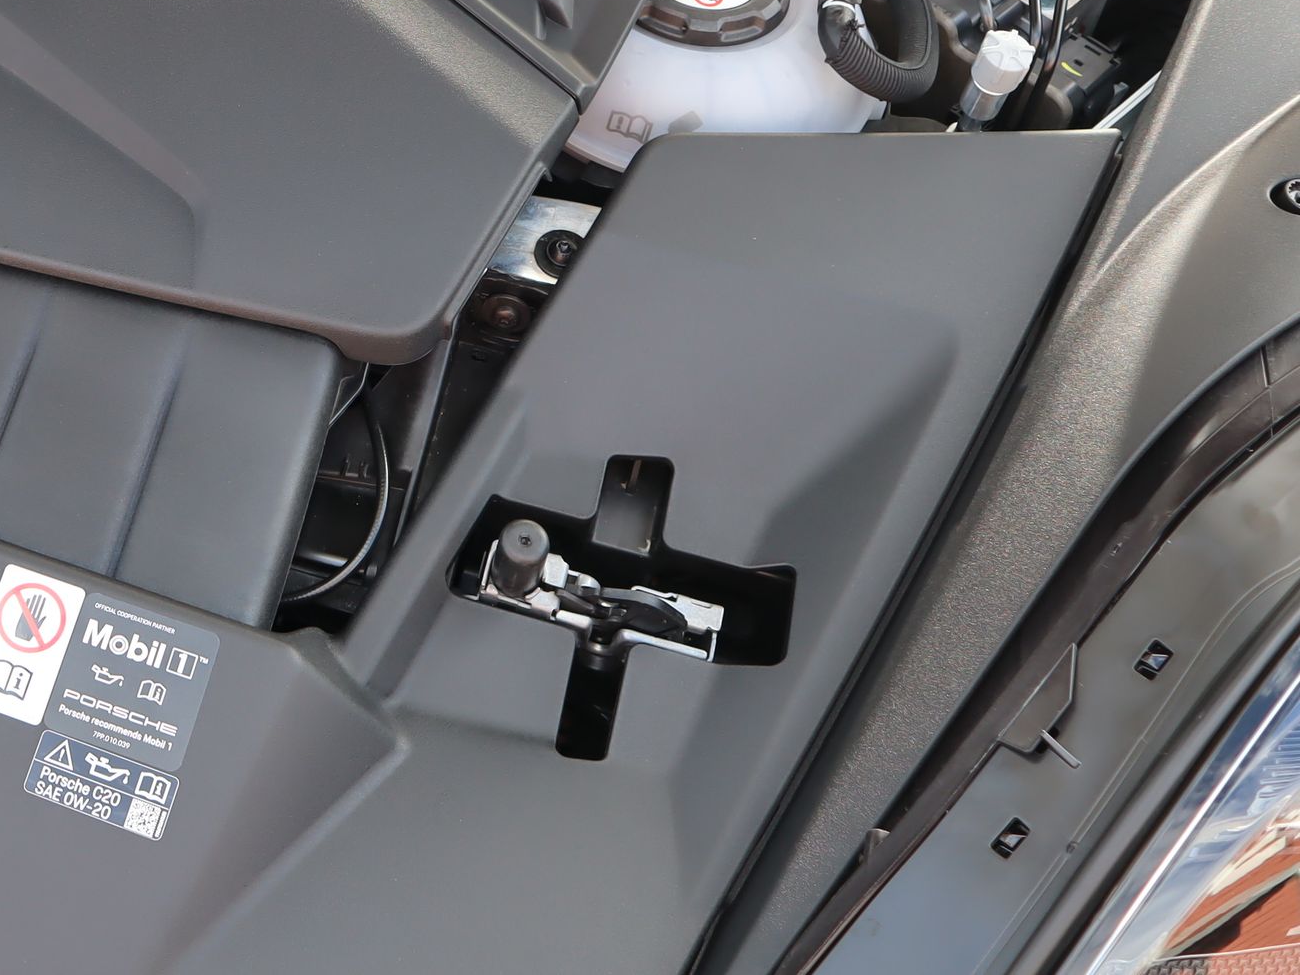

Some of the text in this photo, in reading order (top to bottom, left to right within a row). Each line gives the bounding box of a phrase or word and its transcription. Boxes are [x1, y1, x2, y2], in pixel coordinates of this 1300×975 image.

[95, 602, 176, 635] OFFICIAL COOPERATION PARTNER
[82, 618, 167, 669] Mobil
[58, 704, 173, 751] Porsche recommends Mobil 1
[63, 689, 178, 737] PORSCHE
[34, 781, 112, 820] SAE 0W-20
[39, 765, 121, 807] Porsche C20
